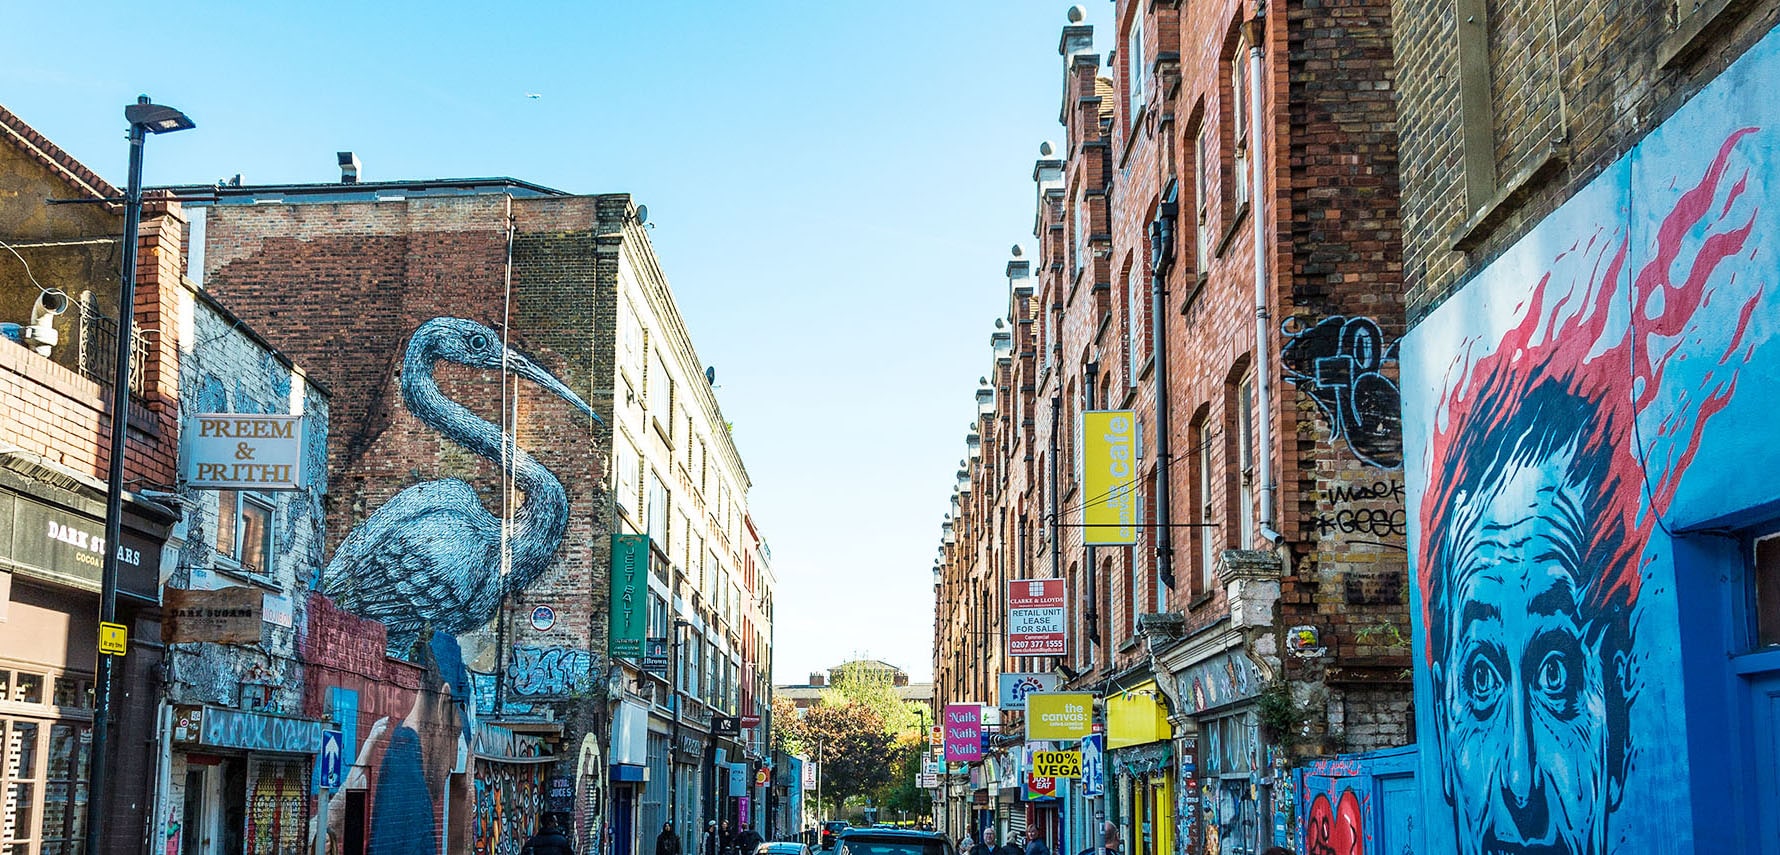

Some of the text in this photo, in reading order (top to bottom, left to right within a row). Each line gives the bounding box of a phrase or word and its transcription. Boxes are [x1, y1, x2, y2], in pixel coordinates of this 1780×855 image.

[199, 419, 294, 439] PREEM
[235, 442, 256, 460] &
[1104, 416, 1129, 478] cafe
[195, 463, 292, 482] PRITHI
[1106, 485, 1119, 509] the
[48, 520, 140, 566] DARK SUARS
[76, 551, 99, 567] COCOA
[171, 608, 252, 617] DARK SUGARS
[1042, 608, 1061, 616] UNIT
[1036, 624, 1058, 632] SALE
[1031, 640, 1044, 648] 377
[1026, 676, 1044, 692] WOR
[1065, 703, 1083, 713] the
[949, 711, 977, 723] Nails
[1041, 713, 1088, 722] canvas:
[949, 727, 977, 739] Nails
[949, 743, 977, 755] Nails
[1037, 753, 1078, 764] 100%
[1038, 765, 1081, 776] VEGA
